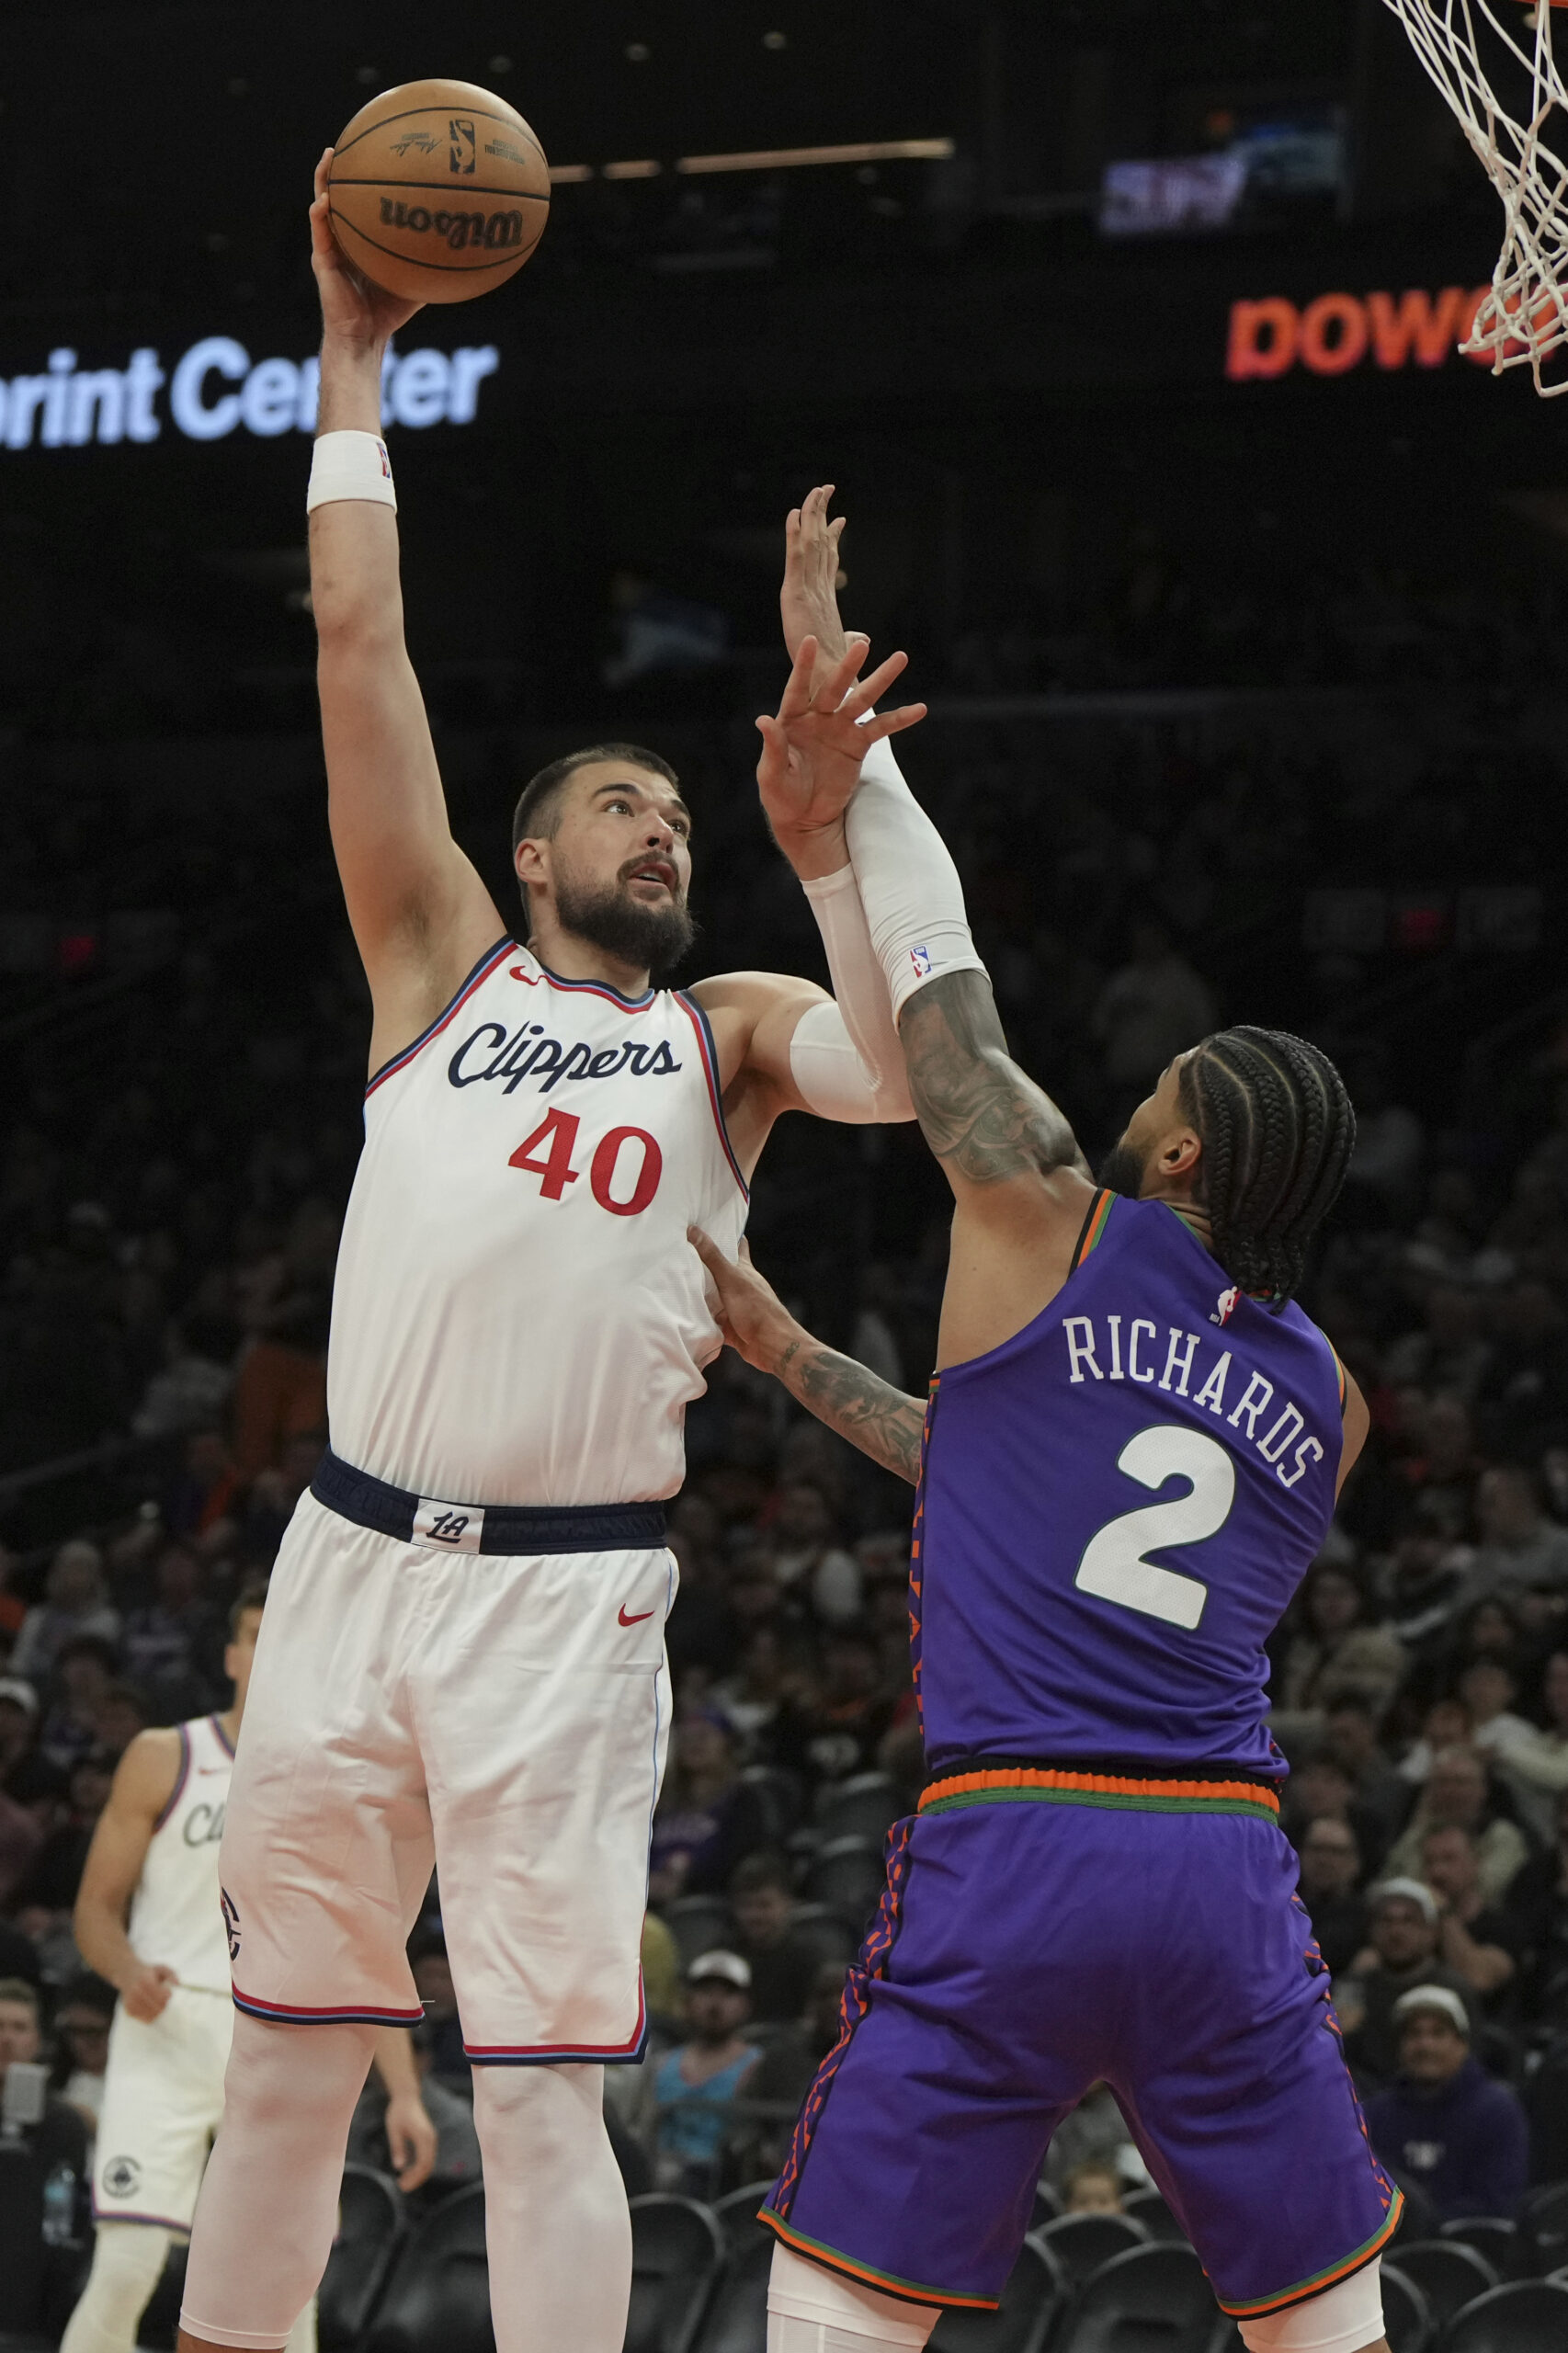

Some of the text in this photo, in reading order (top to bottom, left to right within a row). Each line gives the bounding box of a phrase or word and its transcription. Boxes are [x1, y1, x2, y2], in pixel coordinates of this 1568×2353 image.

[380, 196, 523, 250] Wilson
[0, 347, 165, 449] rint
[448, 1020, 682, 1095] Clippers
[508, 1107, 663, 1216] 40
[1062, 1315, 1324, 1487] RICHARDS
[426, 1510, 469, 1544] LA
[1074, 1423, 1236, 1631] 2
